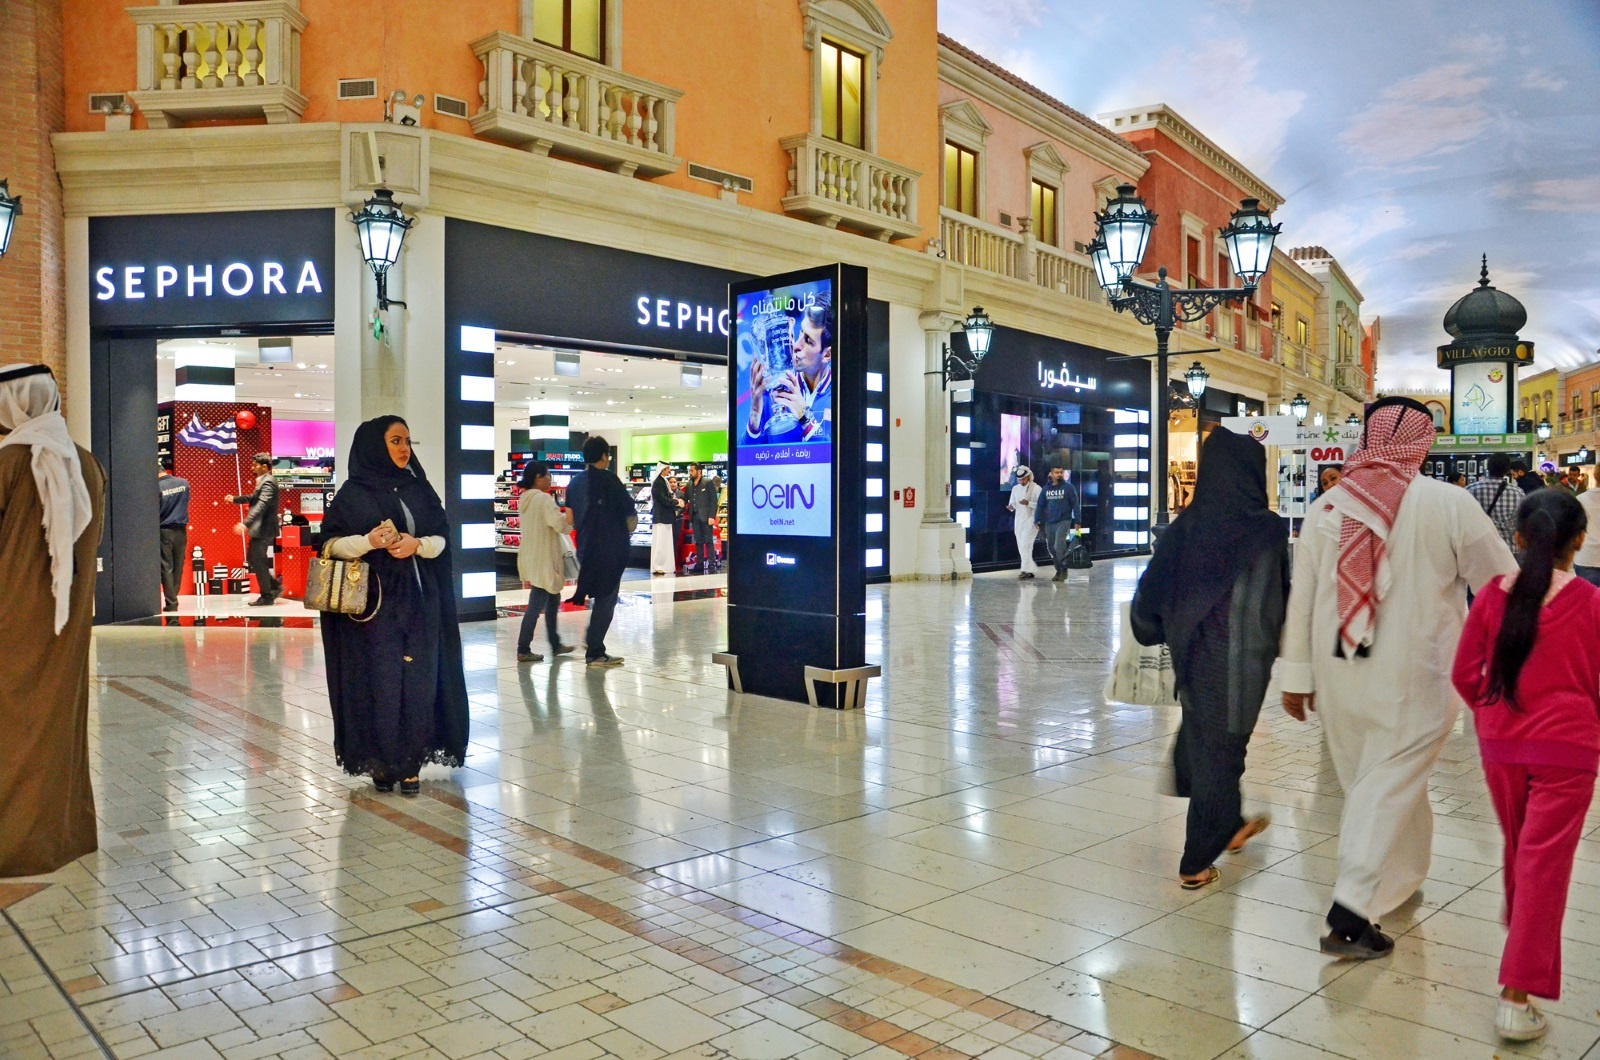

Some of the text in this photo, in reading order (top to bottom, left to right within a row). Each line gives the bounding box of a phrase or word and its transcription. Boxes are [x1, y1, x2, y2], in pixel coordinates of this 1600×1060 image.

[96, 260, 323, 301] SEPHORA
[784, 295, 795, 311] ما
[797, 291, 816, 312] كل
[1445, 346, 1511, 359] VILLAGGIO
[1038, 360, 1097, 393] سيفورا
[162, 485, 186, 497] SECURITY
